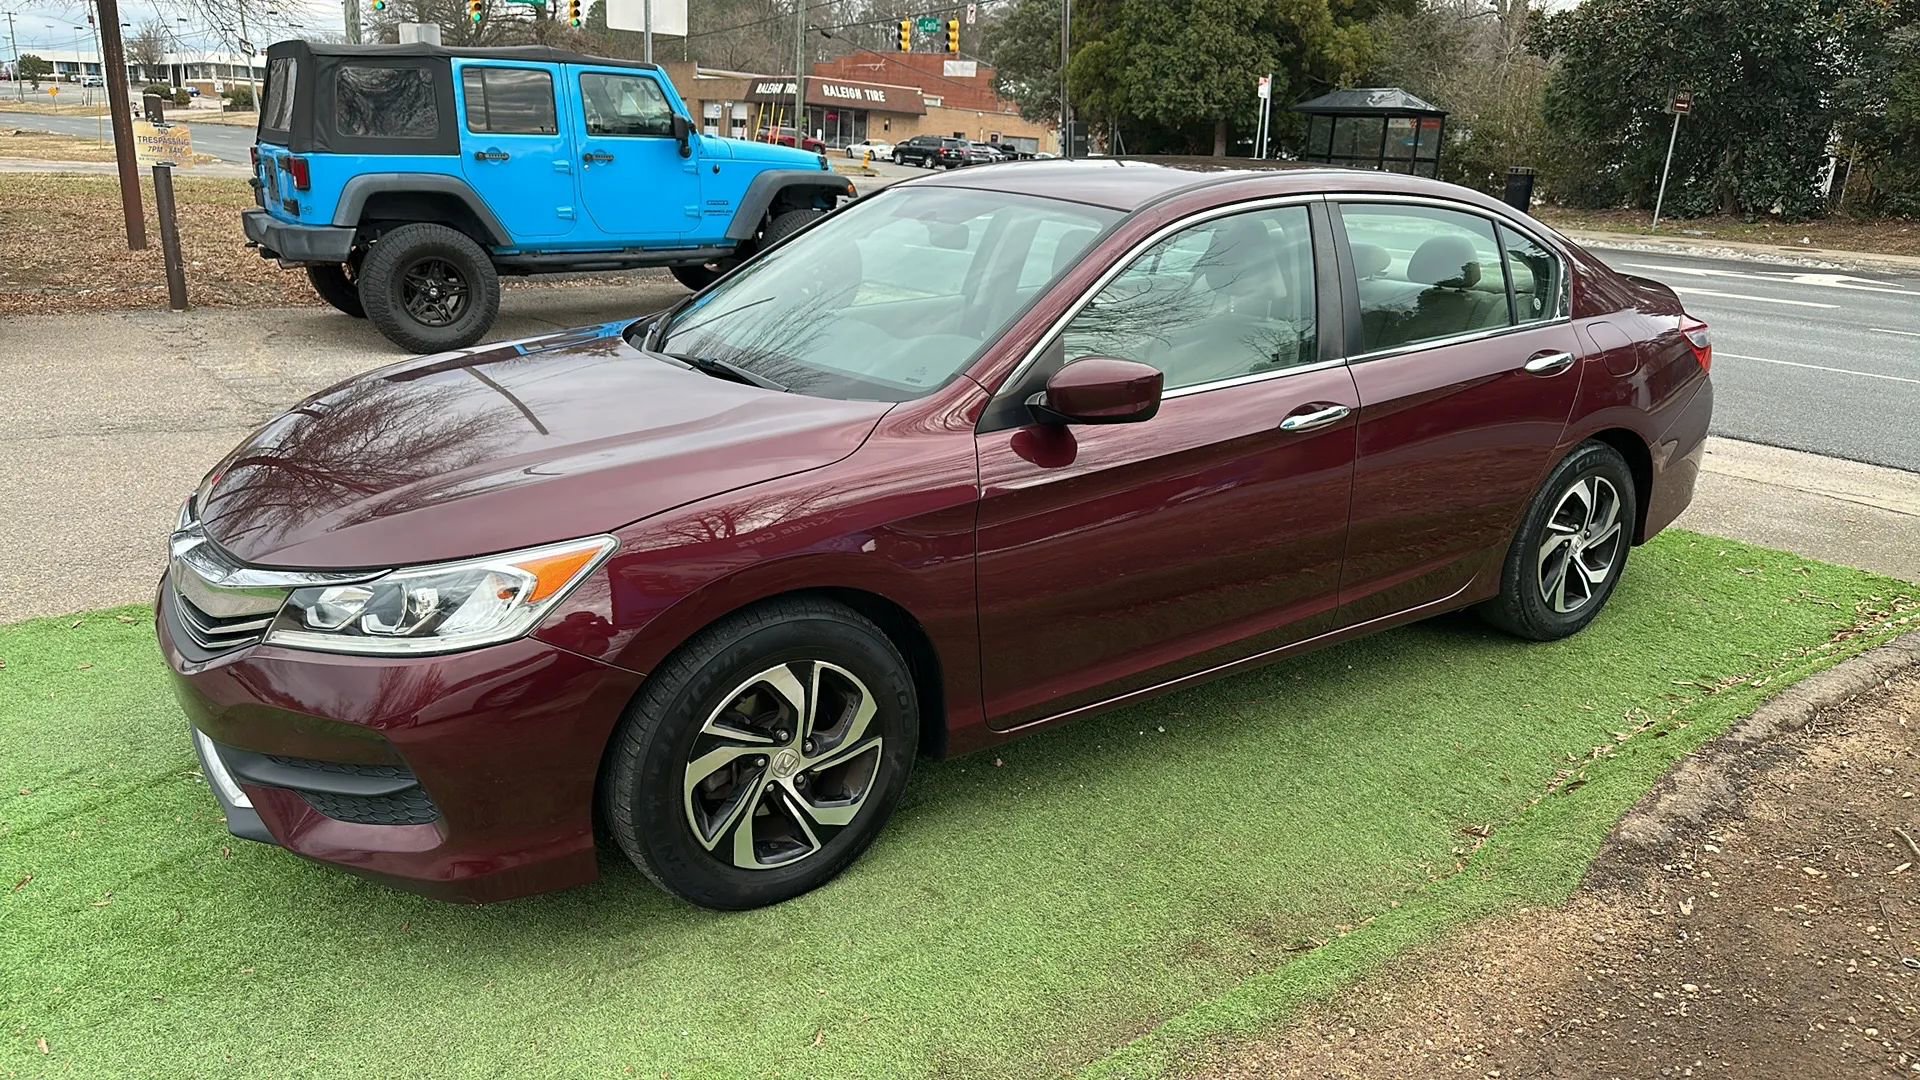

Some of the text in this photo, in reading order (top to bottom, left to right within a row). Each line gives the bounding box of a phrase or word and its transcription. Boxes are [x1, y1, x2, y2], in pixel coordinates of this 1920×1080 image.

[756, 83, 798, 94] RALEIGH TIRE
[822, 84, 886, 102] RALEIGH TIRE
[137, 136, 190, 146] TRESPASSING
